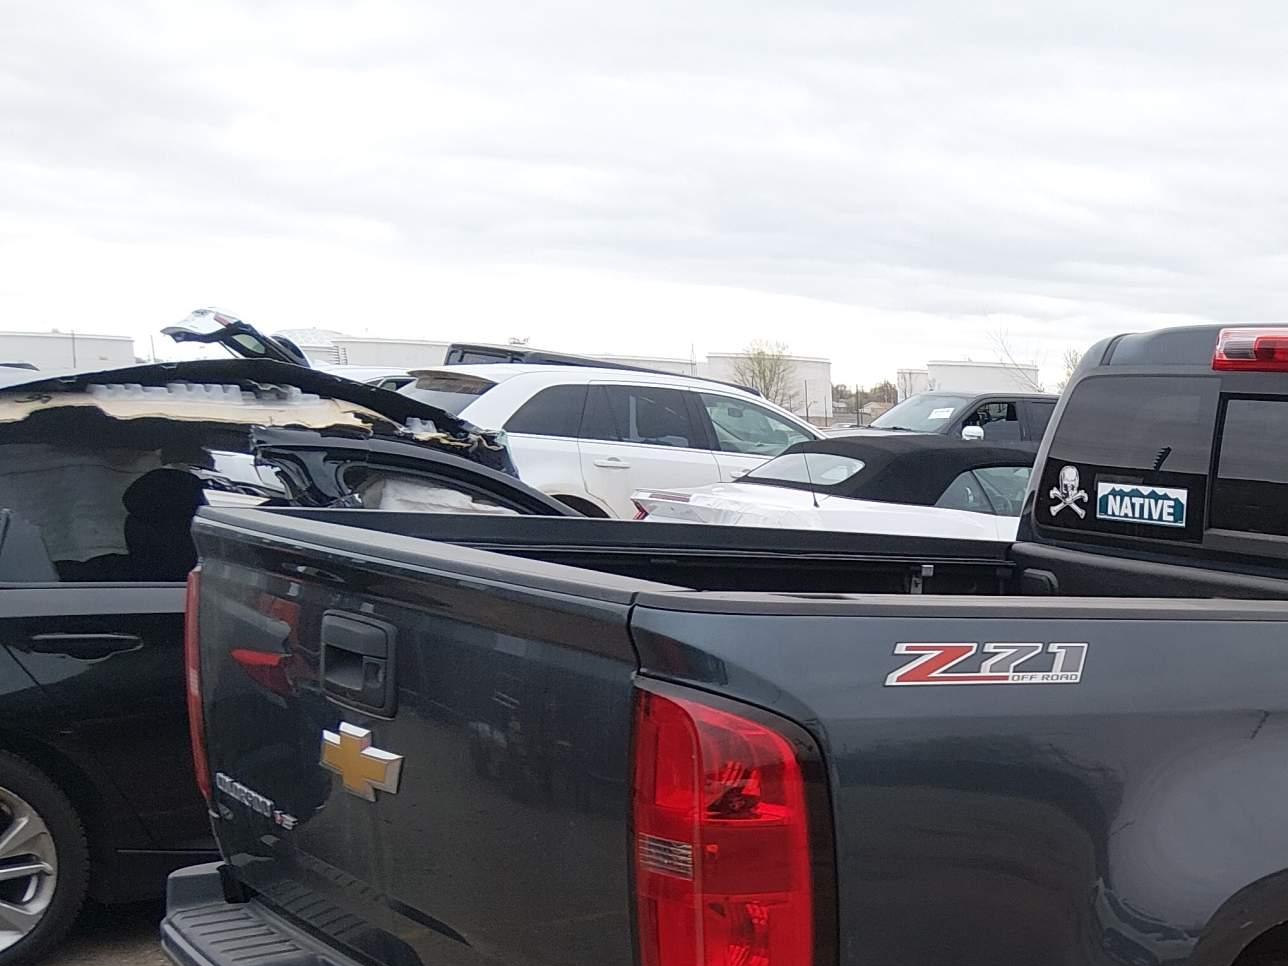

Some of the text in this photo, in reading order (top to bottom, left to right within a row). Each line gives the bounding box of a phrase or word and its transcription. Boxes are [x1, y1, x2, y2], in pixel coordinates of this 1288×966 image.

[1107, 494, 1175, 521] NATIVE
[885, 643, 1088, 686] Z71
[1011, 673, 1079, 682] OFF ROAD
